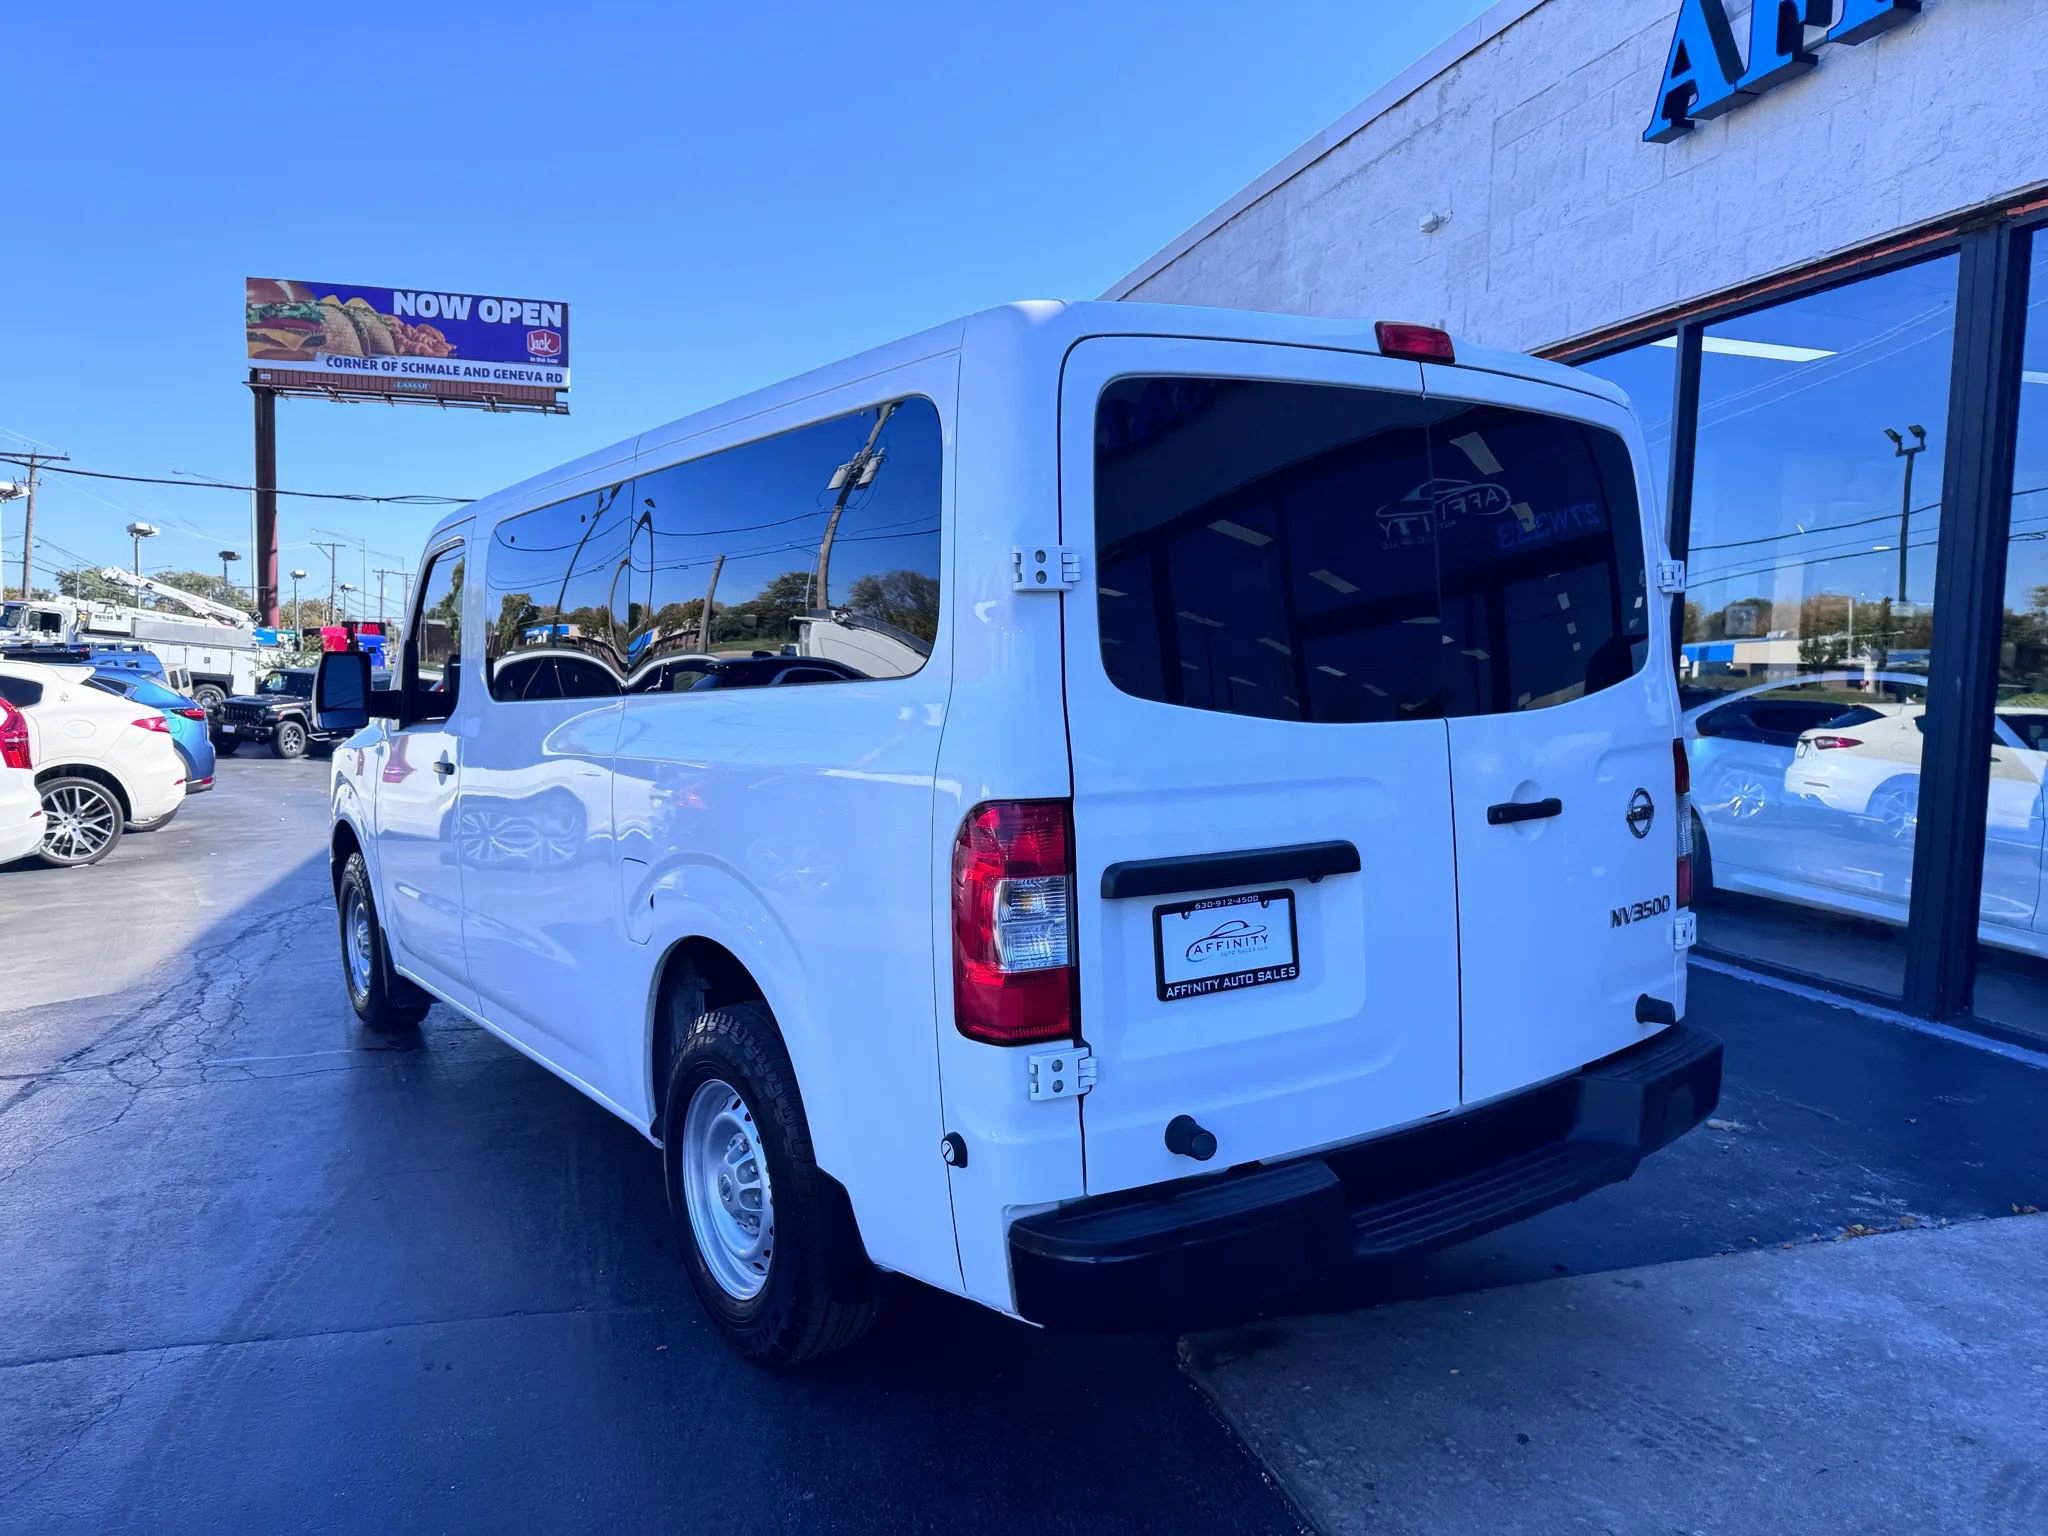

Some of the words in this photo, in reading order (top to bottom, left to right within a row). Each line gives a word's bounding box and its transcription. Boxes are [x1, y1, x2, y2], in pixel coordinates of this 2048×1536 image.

[393, 291, 472, 320] NOW
[478, 298, 561, 327] OPEN
[530, 332, 559, 353] Jack
[326, 355, 378, 370] CORNER
[381, 361, 398, 372] OF
[401, 361, 460, 376] SCHMALE
[463, 366, 490, 378] AND
[493, 369, 543, 382] GENEVA
[546, 372, 563, 383] RD
[1610, 895, 1671, 928] NV3500
[1194, 934, 1269, 955] AFFINITY
[1166, 979, 1220, 998] AFFINITY
[1223, 973, 1254, 988] AUTO
[1257, 966, 1296, 982] SALES
